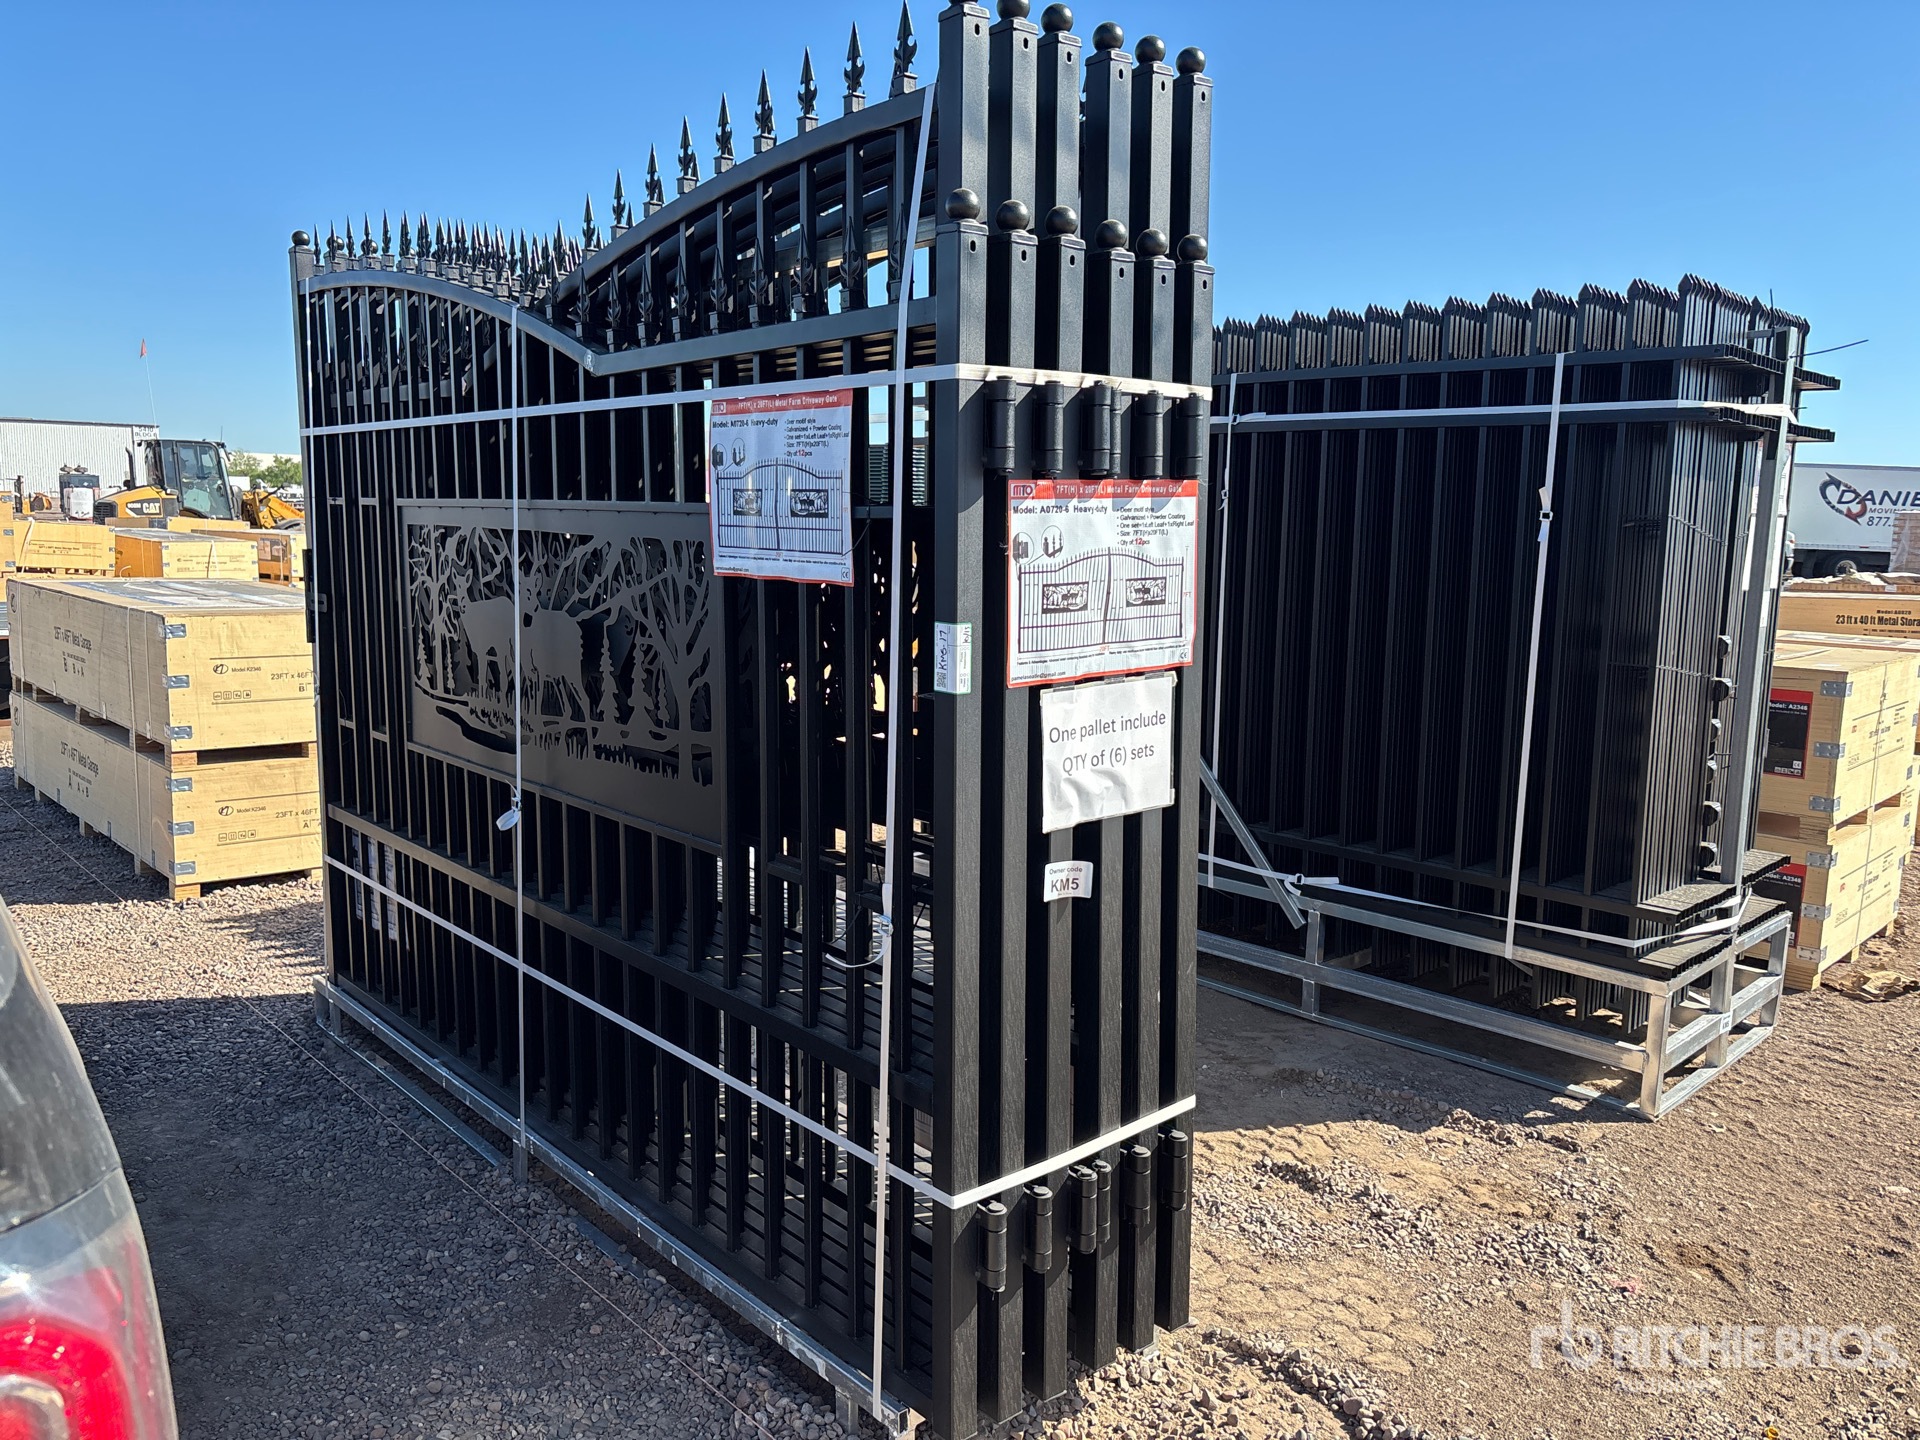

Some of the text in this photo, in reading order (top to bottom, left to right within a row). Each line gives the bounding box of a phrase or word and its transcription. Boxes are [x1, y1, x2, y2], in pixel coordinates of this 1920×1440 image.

[775, 399, 788, 407] Metal
[788, 397, 801, 406] Farm
[802, 396, 824, 405] Driveway
[825, 395, 838, 403] Gate
[712, 420, 729, 428] Model:
[751, 417, 778, 427] Heavy-duty
[1056, 485, 1077, 495] 7FT(H)
[1107, 485, 1123, 493] Metal
[1124, 485, 1140, 493] Farm
[1141, 485, 1167, 494] Driveway
[1168, 485, 1183, 493] Gate
[143, 503, 160, 513] CAT
[1013, 504, 1108, 514] Model: A0720-6 Heavy-duty
[1836, 614, 1846, 625] 23
[1846, 614, 1853, 625] ft
[1853, 616, 1858, 625] x
[1859, 615, 1869, 625] 40
[1870, 615, 1876, 626] ft
[1877, 615, 1899, 626] Metal
[80, 633, 92, 654] Garage
[296, 671, 313, 679] 46FT
[1049, 710, 1166, 743] One pallet include
[1063, 744, 1155, 776] QTY of (6) sets
[87, 755, 99, 778] Garage
[275, 811, 293, 819] 23FT
[300, 808, 318, 816] 46FT
[1051, 878, 1080, 893] KM5
